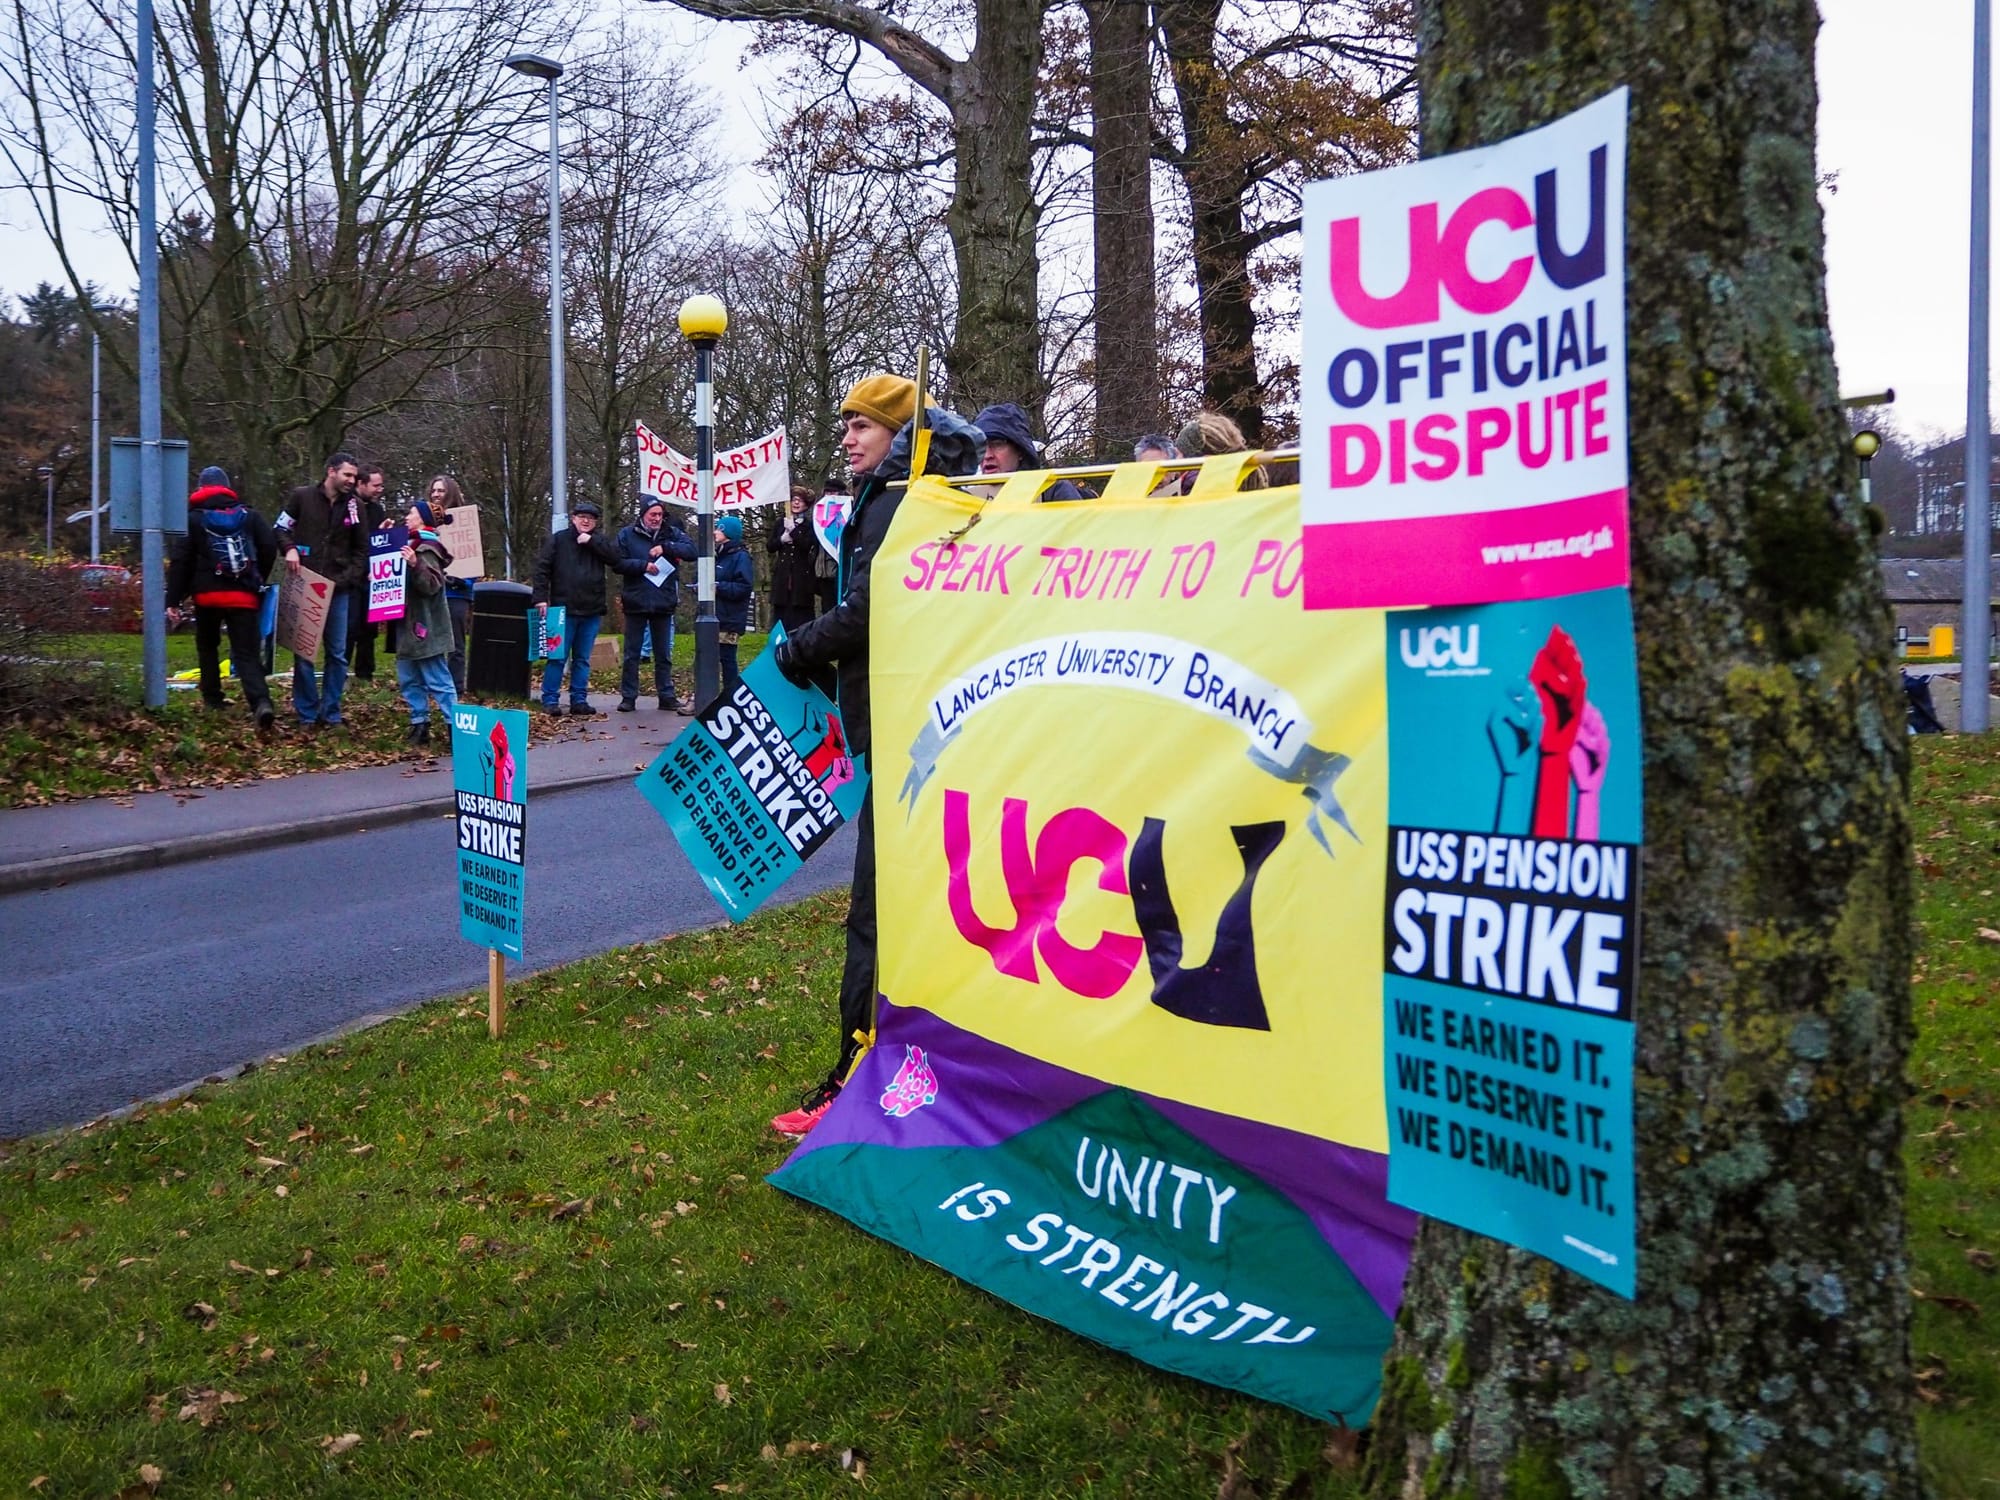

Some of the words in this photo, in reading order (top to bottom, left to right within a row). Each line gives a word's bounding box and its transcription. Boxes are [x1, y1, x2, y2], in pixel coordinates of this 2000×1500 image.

[1329, 143, 1608, 329] UCU
[1327, 300, 1607, 409] OFFICIAL
[636, 426, 783, 476] SOIARITY
[1329, 379, 1609, 489] DISPUTE
[371, 534, 388, 546] UCU
[373, 558, 402, 580] UCU
[448, 529, 474, 544] THE
[902, 541, 1024, 595] SPEAK
[1032, 546, 1152, 600] TRUTH
[1160, 540, 1217, 599] TO
[1240, 538, 1303, 599] PO
[303, 597, 324, 628] MY
[372, 589, 402, 603] DISPUTE
[373, 579, 402, 592] OFFICIAL
[296, 624, 317, 656] JOB
[1400, 624, 1479, 668] UCU
[455, 712, 477, 731] UCU
[935, 650, 1047, 731] LANCASTER
[1056, 640, 1174, 686] UNIVERSITY
[1183, 652, 1296, 750] BRANCH
[706, 705, 822, 852] STRIKE
[732, 685, 773, 731] USS
[764, 726, 839, 826] PENSION
[458, 792, 477, 814] USS
[478, 798, 522, 825] PENSION
[659, 763, 687, 796] WE
[682, 792, 737, 871] DEMAND
[734, 871, 755, 898] IT.
[673, 748, 702, 781] WE
[699, 777, 755, 859] DESERVE
[750, 859, 772, 883] IT.
[688, 732, 716, 765] WE
[713, 761, 768, 841] EARNED
[765, 841, 787, 869] IT.
[460, 815, 521, 863] STRIKE
[461, 858, 473, 875] WE
[475, 862, 507, 885] EARNED
[509, 873, 519, 890] IT.
[1396, 830, 1459, 881] USS
[1462, 836, 1627, 900] PENSION
[463, 879, 473, 896] WE
[475, 883, 507, 908] DESERVE
[509, 896, 518, 912] IT.
[463, 901, 474, 917] WE
[475, 905, 507, 930] DEMAND
[508, 918, 518, 935] IT.
[944, 789, 1285, 1031] UCU
[1392, 888, 1622, 1013] STRIKE
[1394, 999, 1436, 1042] WE
[1443, 1008, 1561, 1075] EARNED
[1573, 1040, 1611, 1089] IT.
[1395, 1053, 1438, 1098] WE
[1446, 1065, 1569, 1139] DESERVE
[1576, 1103, 1613, 1153] IT.
[1075, 1136, 1237, 1244] UNITY
[1397, 1107, 1441, 1154] WE
[1450, 1121, 1570, 1197] DEMAND
[1579, 1165, 1615, 1217] IT.
[938, 1182, 1011, 1221] IS
[1006, 1212, 1317, 1344] STRENGTH
